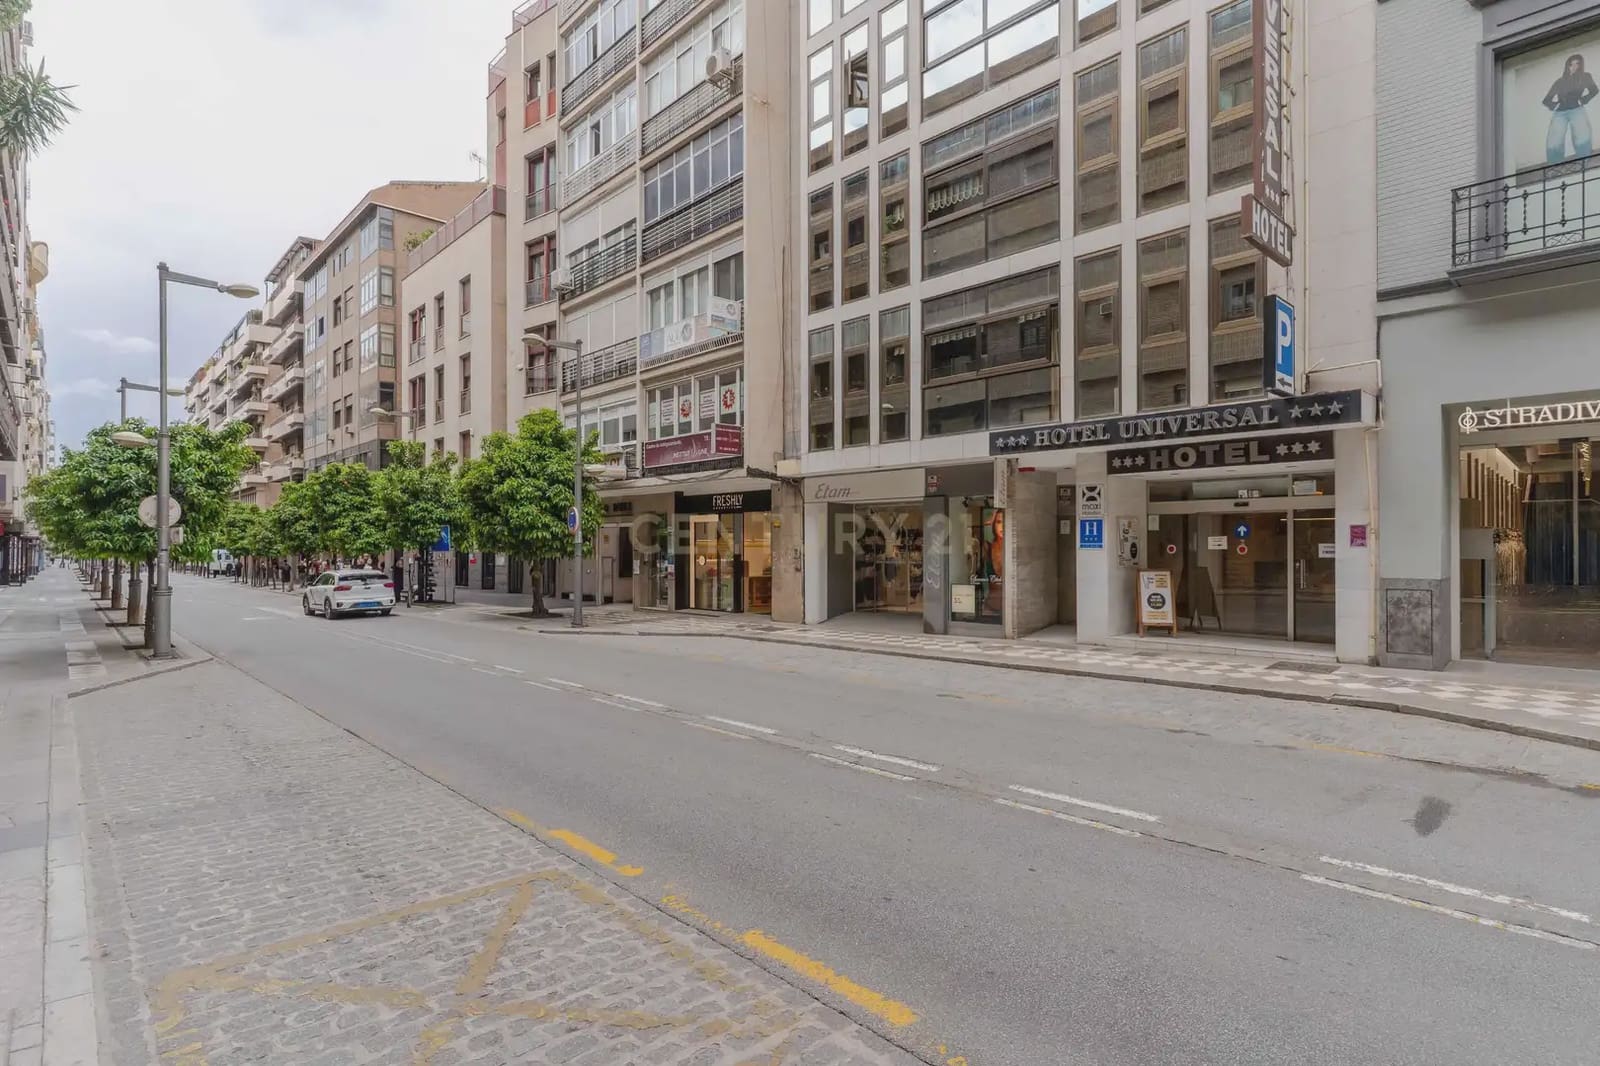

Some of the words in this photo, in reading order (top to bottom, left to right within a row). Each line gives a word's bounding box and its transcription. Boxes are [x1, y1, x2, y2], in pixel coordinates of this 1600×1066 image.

[1252, 202, 1292, 262] HOTEL
[1276, 308, 1292, 366] P
[1034, 423, 1111, 448] HOTEL
[1118, 405, 1280, 440] UNIVERSAL
[1484, 400, 1600, 428] STRADIV
[1150, 441, 1270, 471] HOTEL
[712, 493, 744, 507] FRESHLY
[814, 482, 851, 500] Etam
[1086, 521, 1097, 536] H
